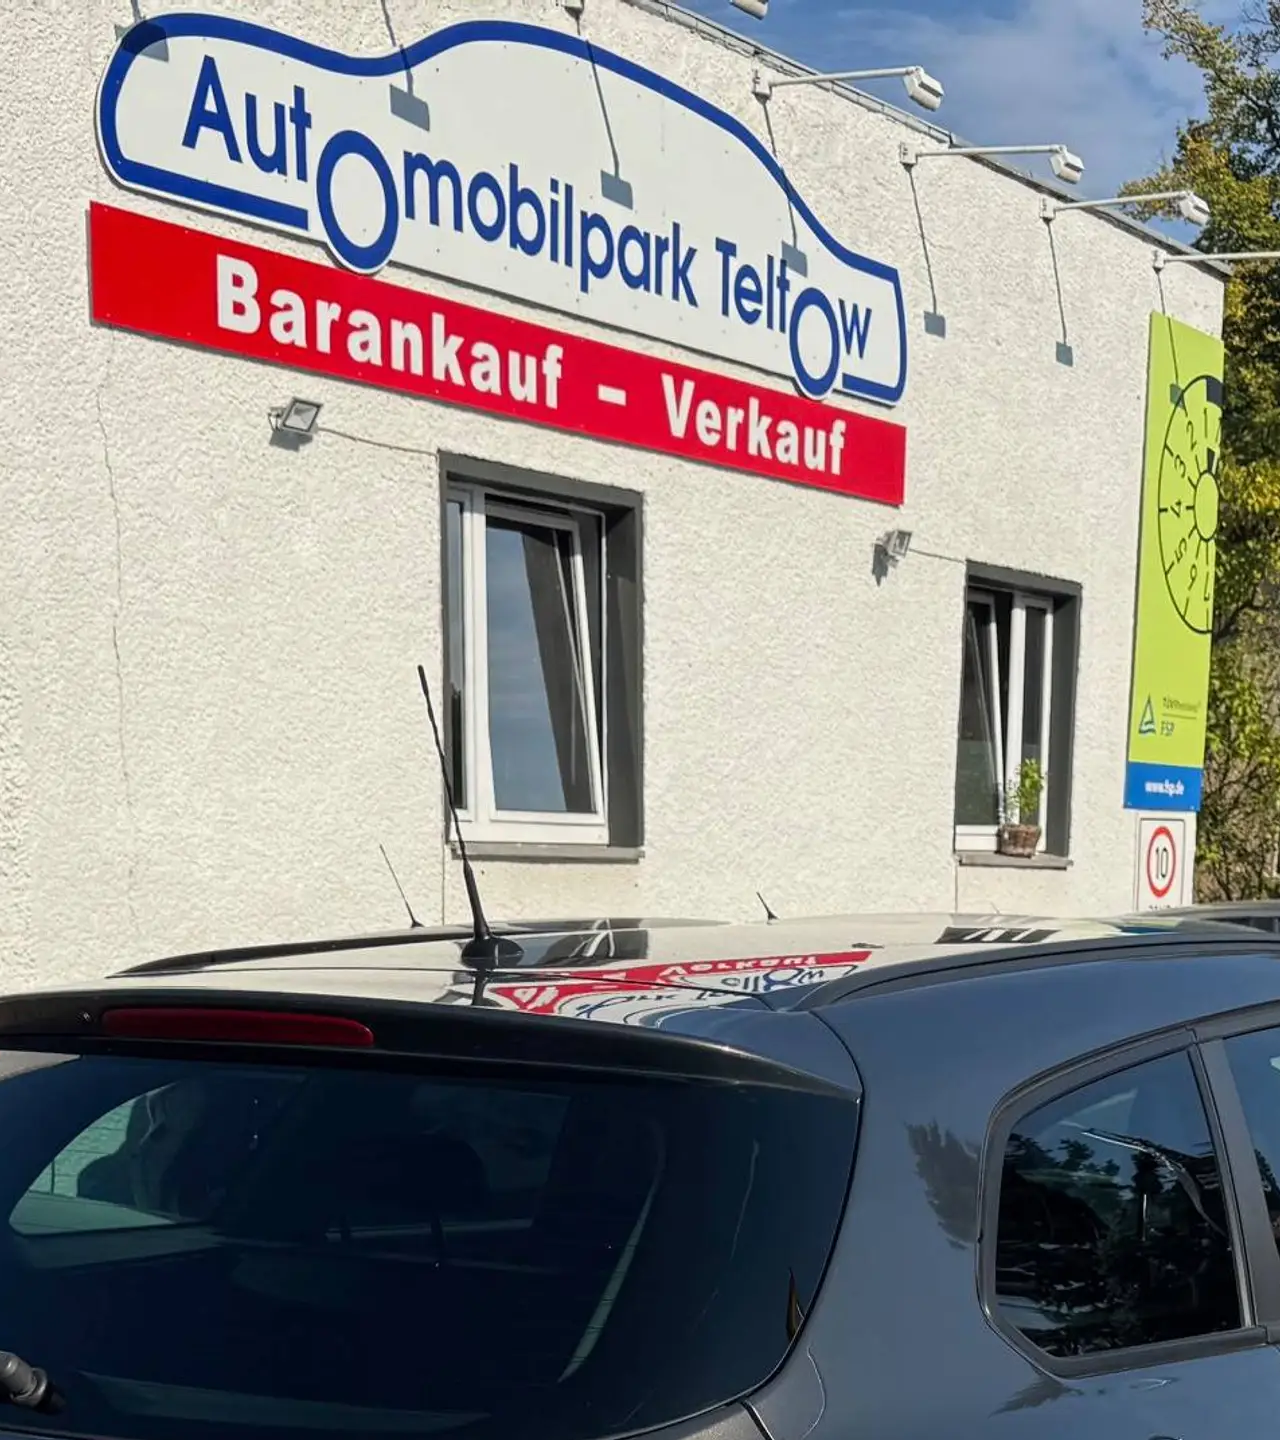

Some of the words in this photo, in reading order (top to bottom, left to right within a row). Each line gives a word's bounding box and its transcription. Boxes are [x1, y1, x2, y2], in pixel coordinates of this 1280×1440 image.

[181, 55, 698, 307] Automobilpark
[714, 239, 873, 398] Teltow
[215, 253, 563, 410] Barankauf
[661, 373, 847, 476] Verkauf
[1155, 846, 1169, 880] 10
